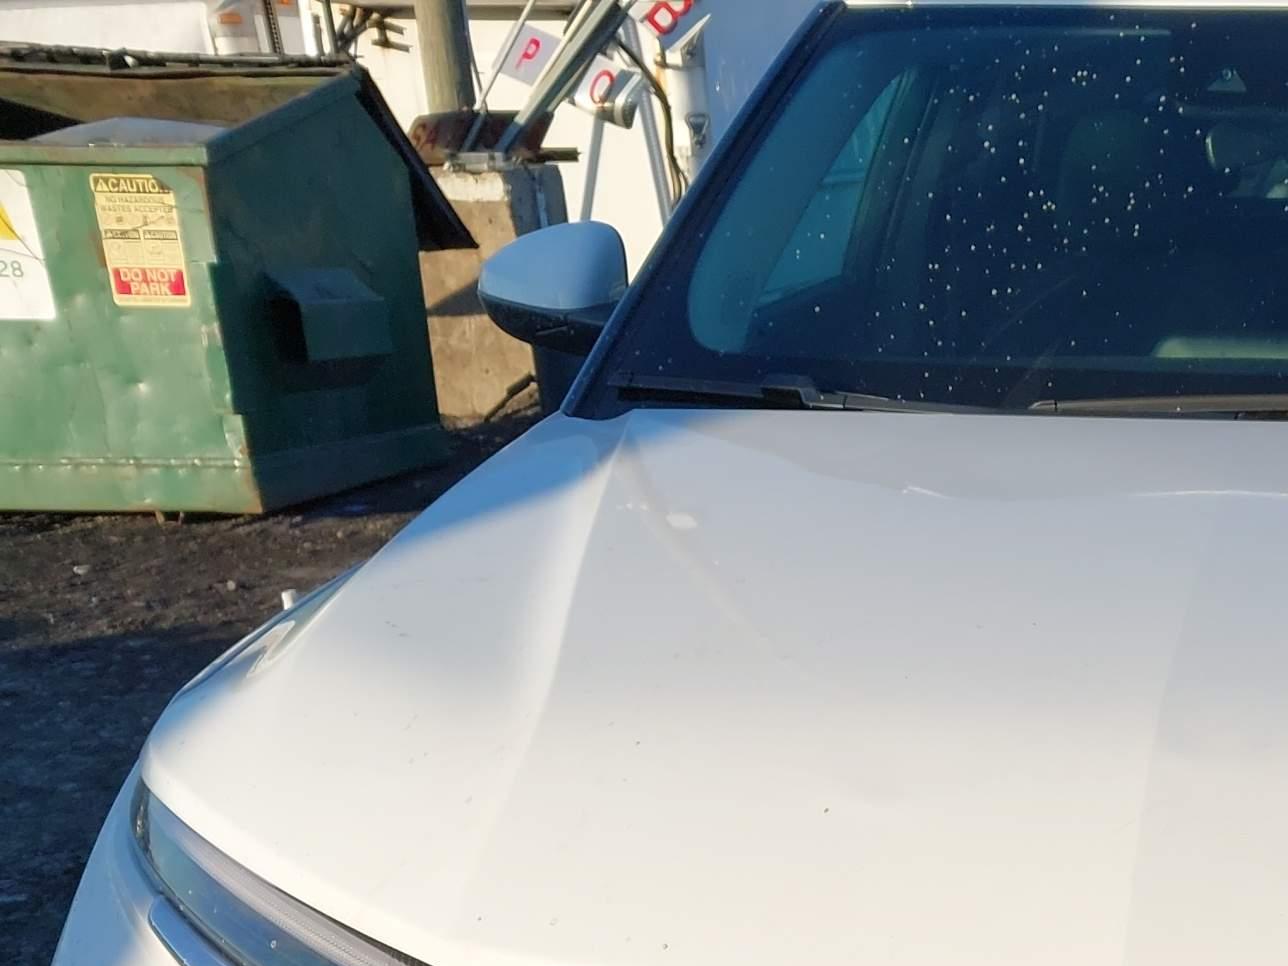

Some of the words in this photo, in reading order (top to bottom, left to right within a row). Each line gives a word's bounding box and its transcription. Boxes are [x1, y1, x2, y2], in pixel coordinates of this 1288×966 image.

[516, 37, 541, 69] P
[108, 178, 168, 192] CAUTIO
[120, 268, 143, 282] DO
[146, 268, 177, 283] NOT
[130, 282, 171, 296] PARK
